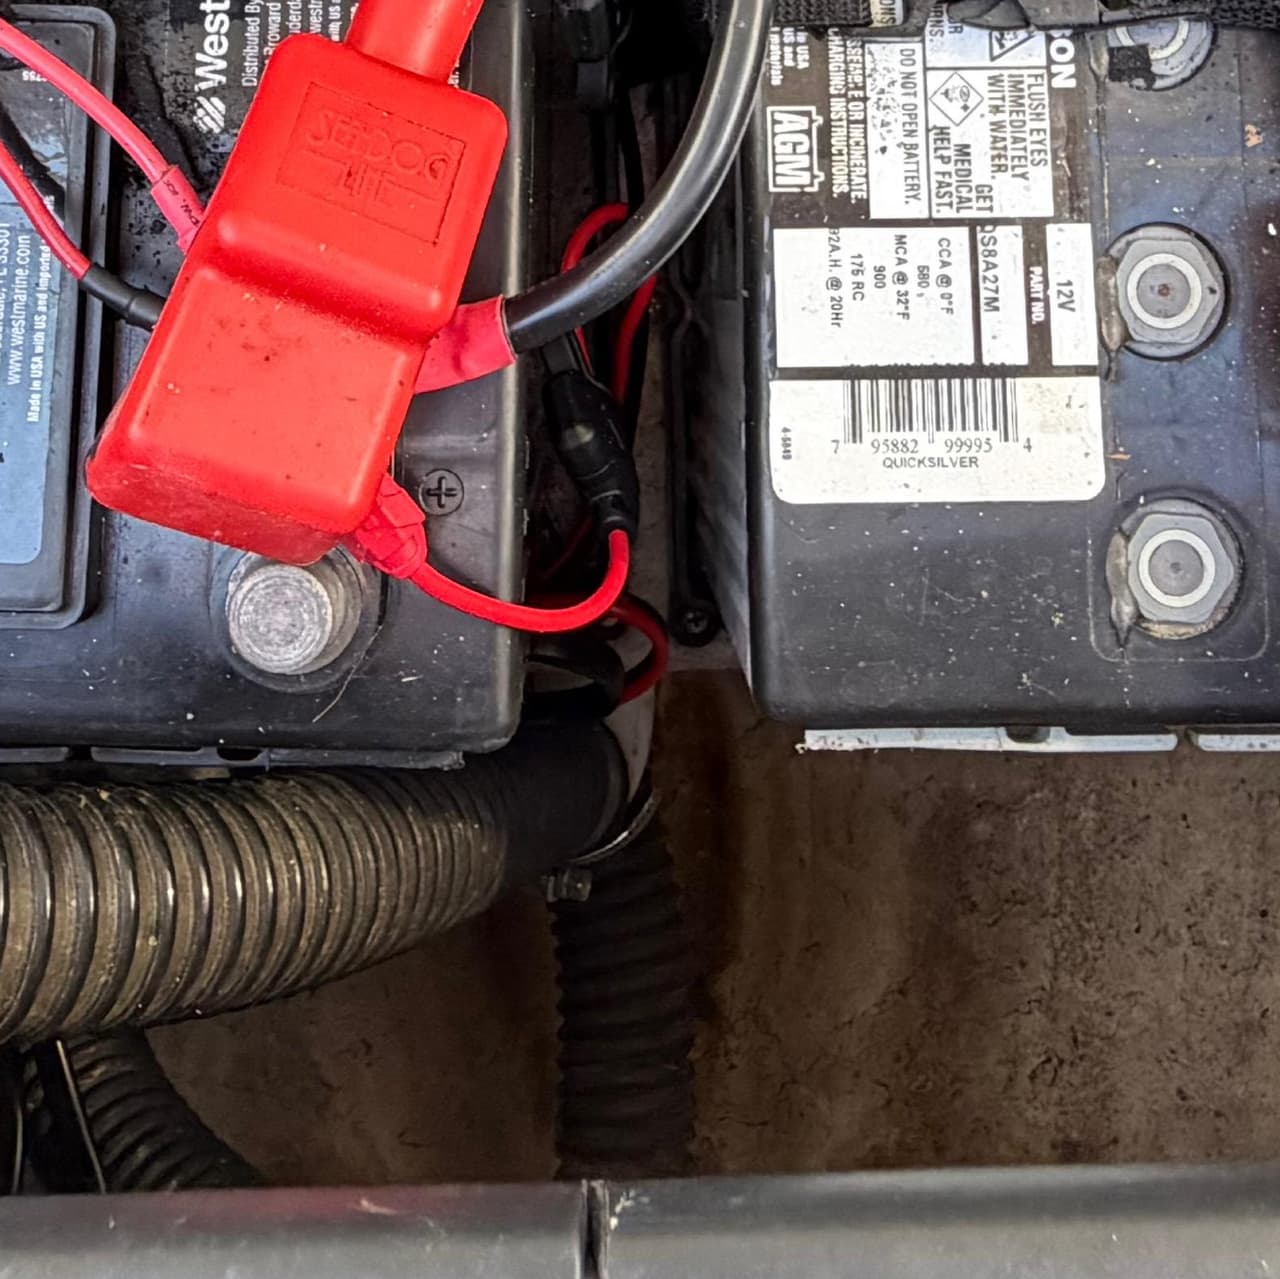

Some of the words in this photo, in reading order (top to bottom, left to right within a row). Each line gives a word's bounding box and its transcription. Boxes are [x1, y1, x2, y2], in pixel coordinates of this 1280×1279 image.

[194, 0, 231, 91] West
[241, 18, 260, 87] Distributed
[899, 48, 916, 67] DO
[901, 71, 918, 100] NOT
[988, 74, 1006, 114] WITH
[1028, 73, 1046, 122] FLUSH
[901, 103, 918, 139] OPEN
[1008, 73, 1029, 180] IMMEDIATELY
[773, 111, 810, 187] AGM
[830, 98, 848, 198] INSTRUCTIONS.
[933, 126, 951, 165] HELP
[989, 120, 1007, 180] WATER.
[1031, 127, 1048, 167] EYES
[846, 124, 867, 204] INCINERATE.
[902, 142, 920, 204] BATTERY.
[955, 143, 973, 214] MEDICAL
[935, 170, 953, 214] FAST.
[976, 184, 993, 213] GET
[894, 234, 908, 266] MCA
[937, 237, 951, 267] CCA
[852, 281, 865, 302] RC
[874, 265, 886, 289] 900
[893, 271, 909, 285] @
[936, 274, 953, 288] @
[1029, 266, 1043, 298] PART
[1031, 302, 1044, 325] NO.
[1057, 280, 1076, 312] 12V
[831, 439, 840, 454] 7
[871, 439, 919, 454] 95882
[944, 438, 993, 453] 99995
[1022, 437, 1032, 452] 4
[882, 456, 979, 469] QUICKSILVER
